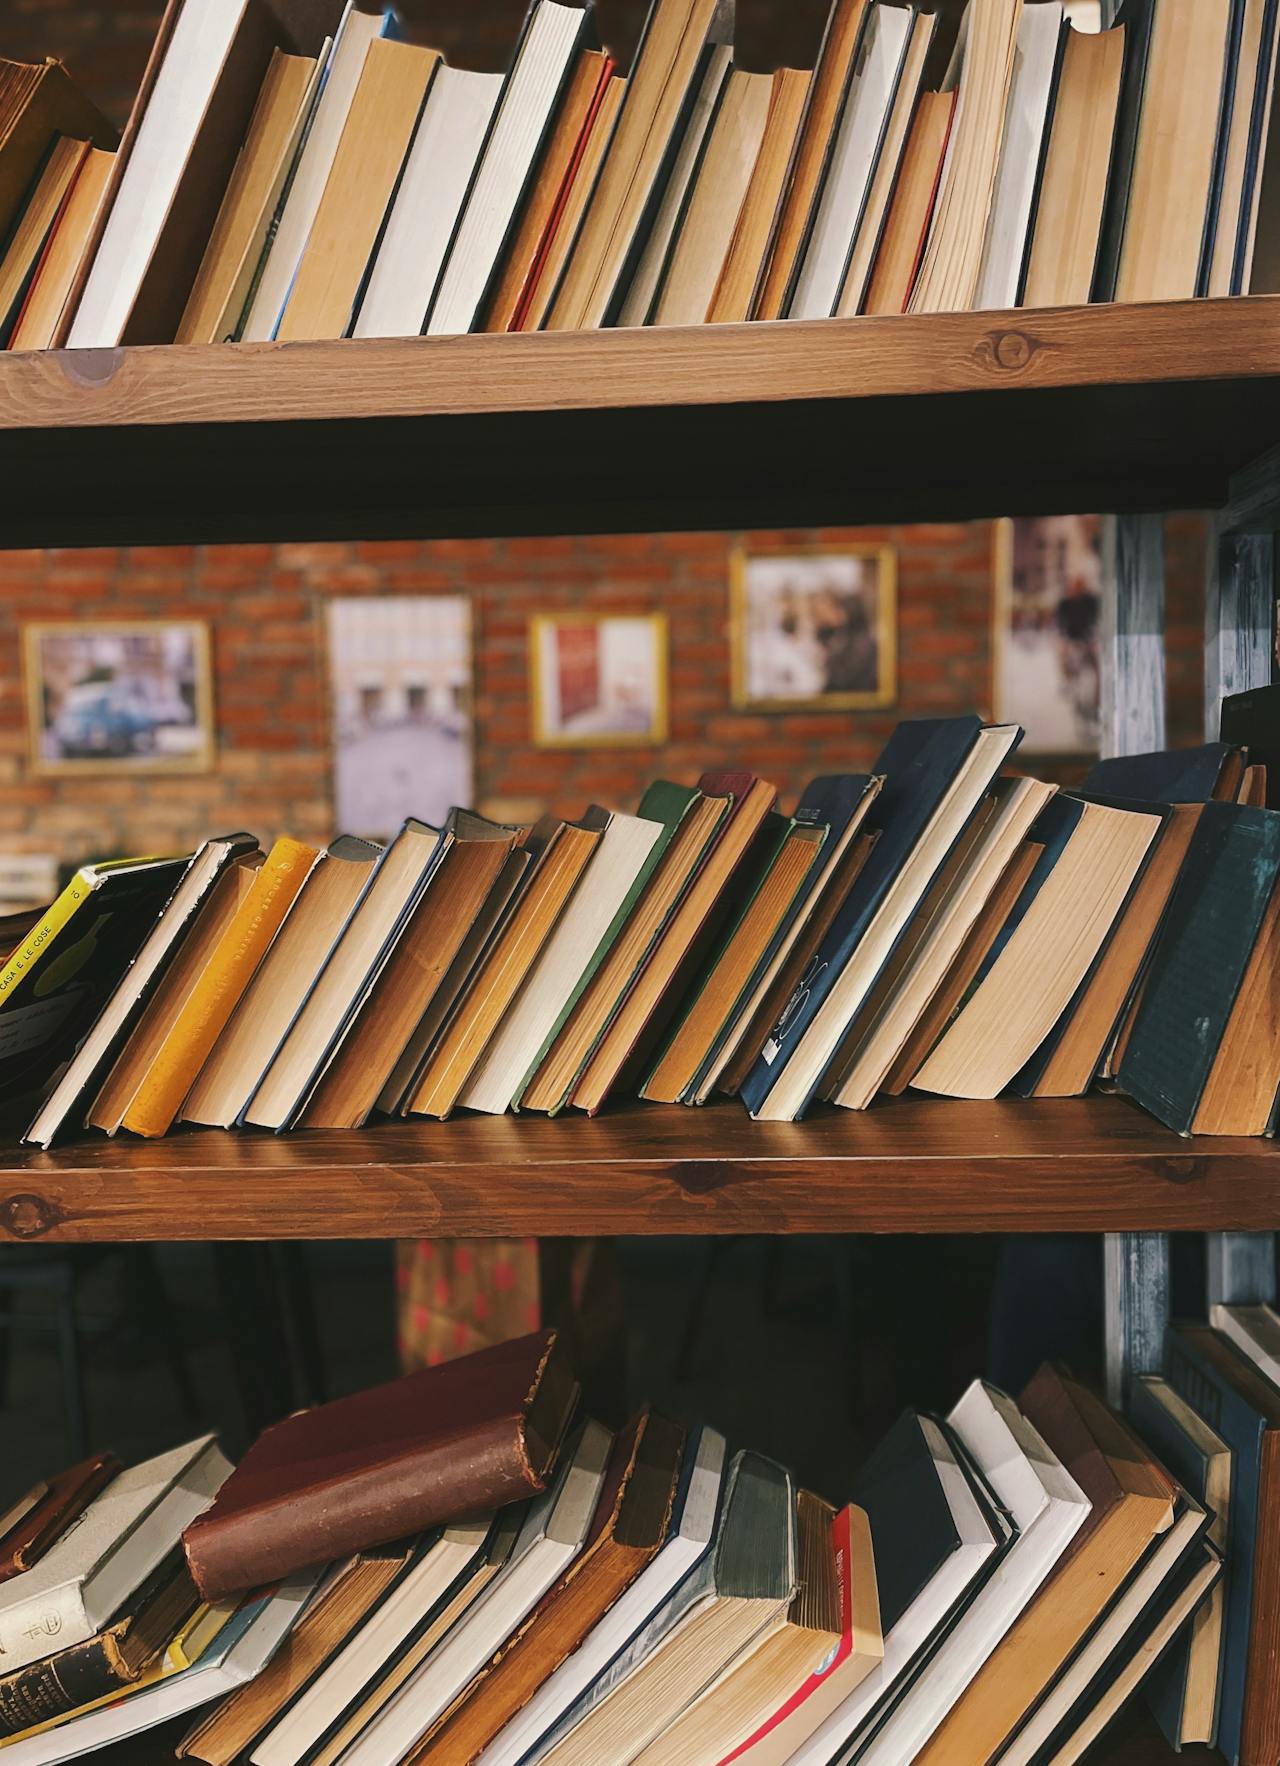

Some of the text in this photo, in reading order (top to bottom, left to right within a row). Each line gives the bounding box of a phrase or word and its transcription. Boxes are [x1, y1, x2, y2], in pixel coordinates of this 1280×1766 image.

[0, 926, 51, 990] CASA E LE COSE
